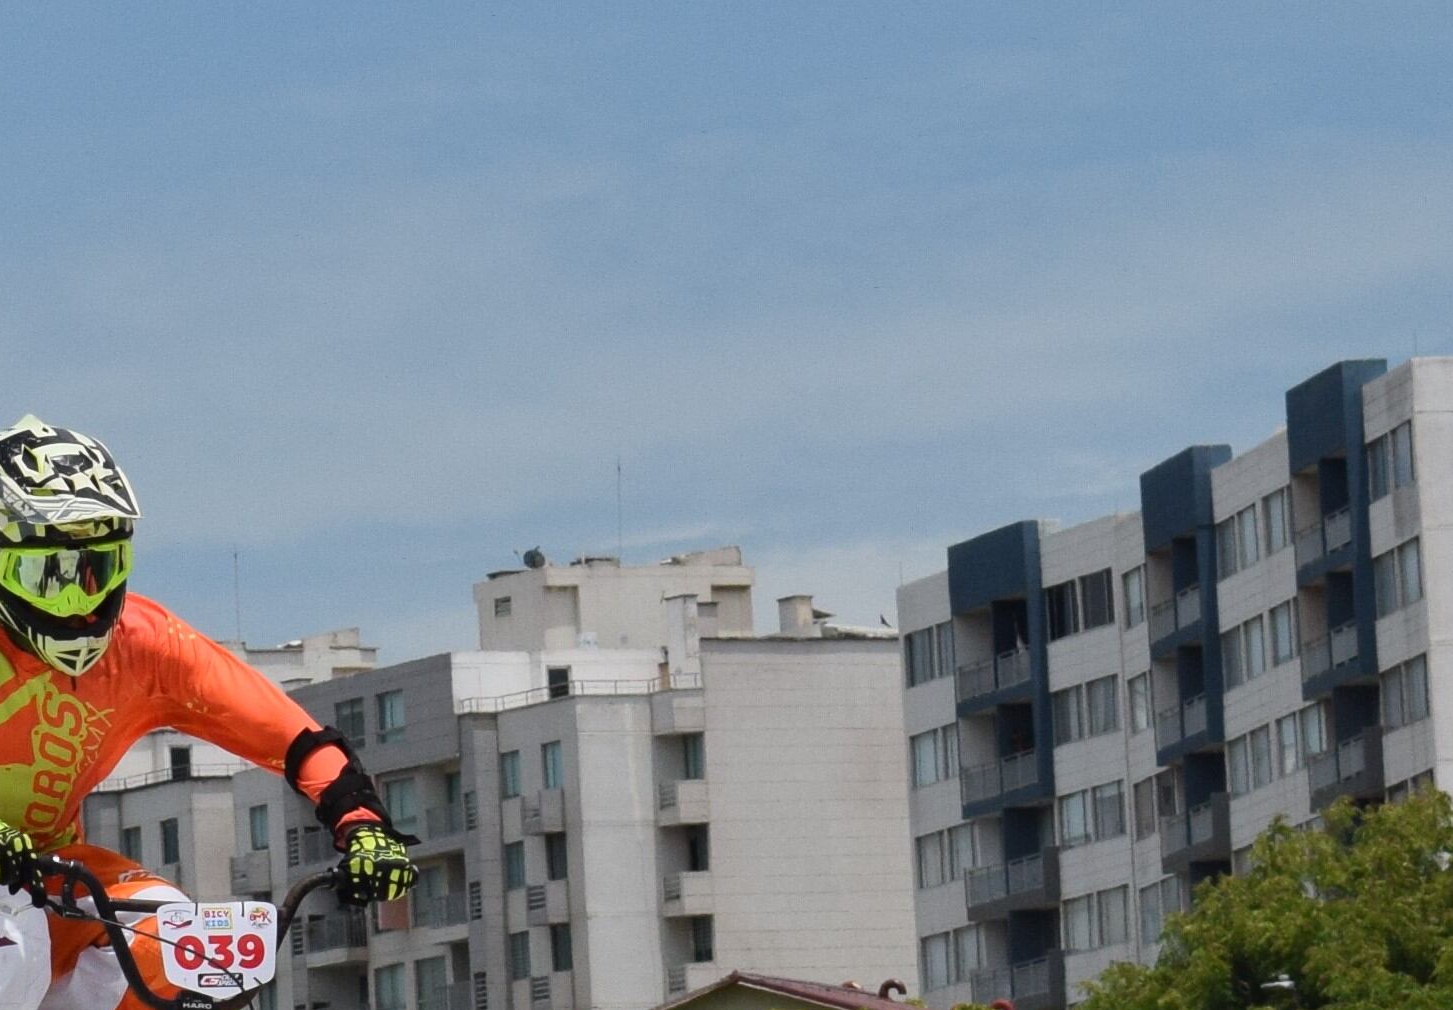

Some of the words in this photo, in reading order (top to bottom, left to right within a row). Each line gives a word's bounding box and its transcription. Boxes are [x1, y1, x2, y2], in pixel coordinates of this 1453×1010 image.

[204, 909, 230, 919] BICY
[205, 919, 229, 928] KIDS
[174, 934, 265, 970] 039
[182, 1001, 213, 1010] HARO
